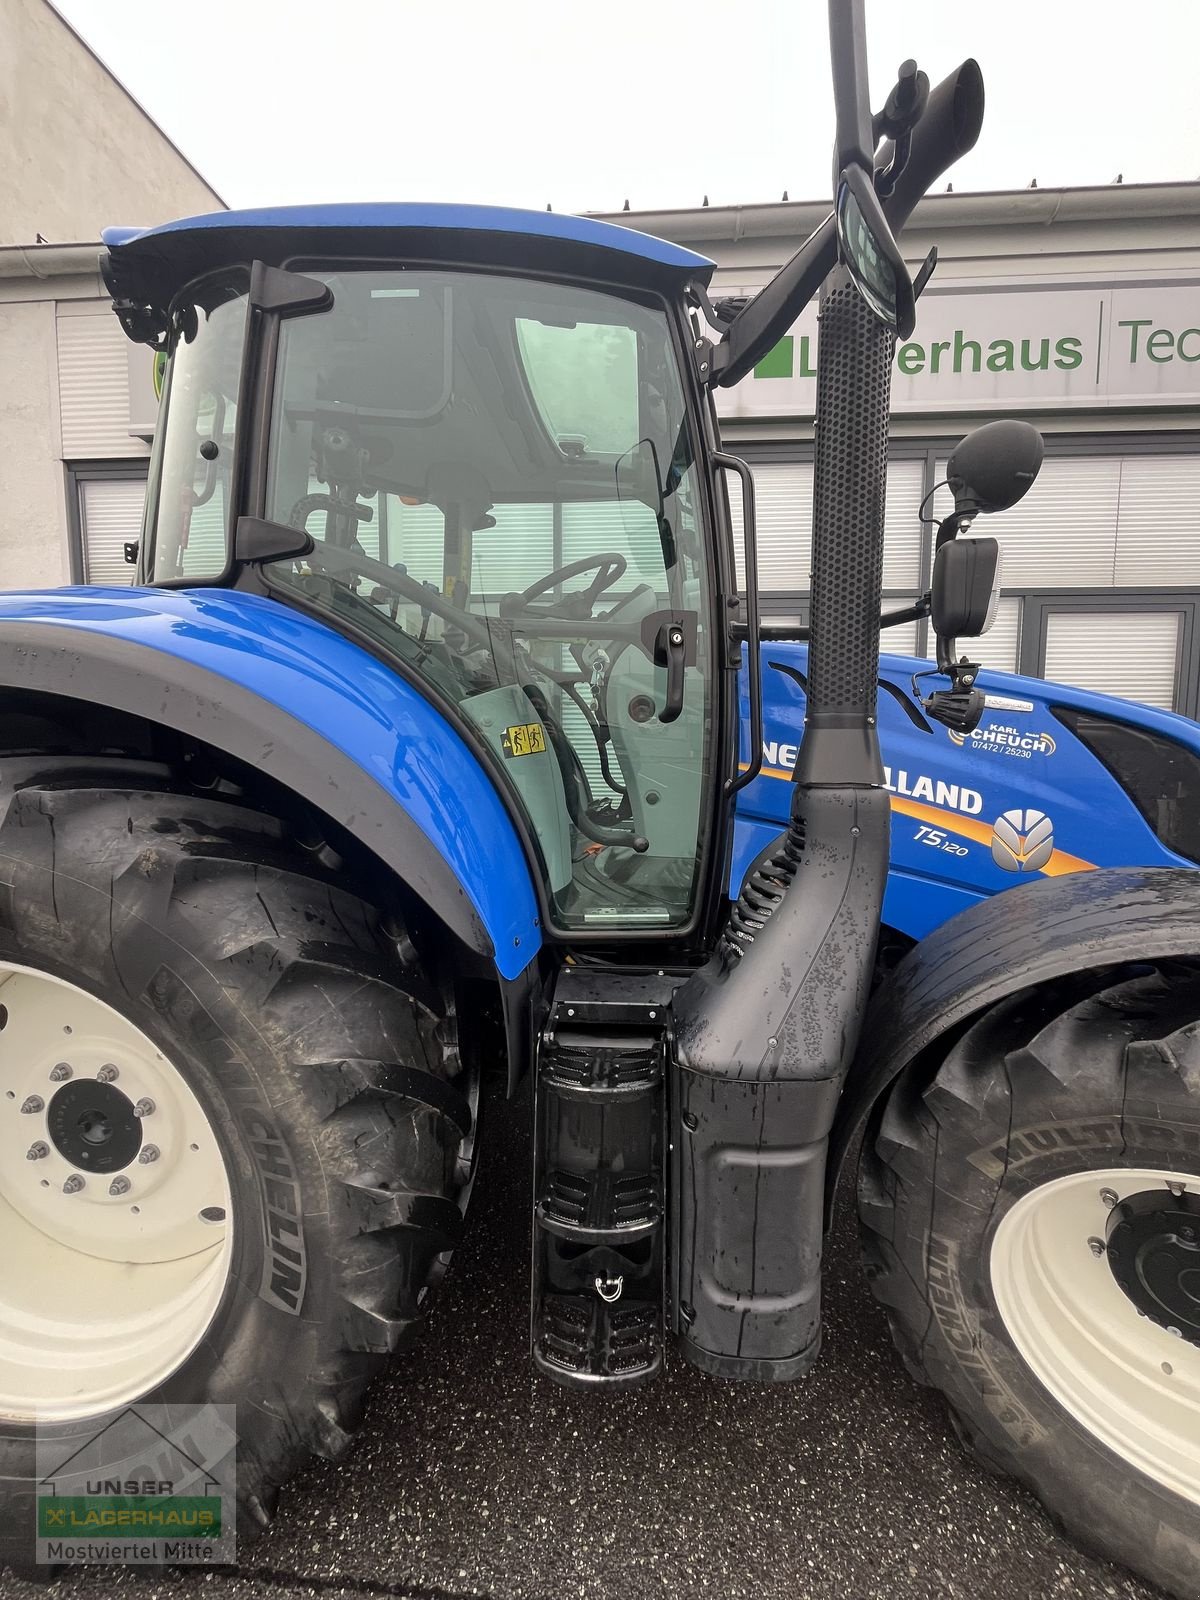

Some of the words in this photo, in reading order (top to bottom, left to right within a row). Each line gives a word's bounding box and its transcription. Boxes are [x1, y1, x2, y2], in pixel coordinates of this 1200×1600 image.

[800, 331, 1083, 378] Lerhaus
[960, 728, 1047, 752] CHEUCH
[989, 724, 1019, 736] KARL
[972, 740, 998, 752] 07472
[1004, 747, 1032, 759] 25230
[763, 742, 801, 769] NE
[871, 767, 983, 815] LLAND
[913, 825, 969, 857] T5.120
